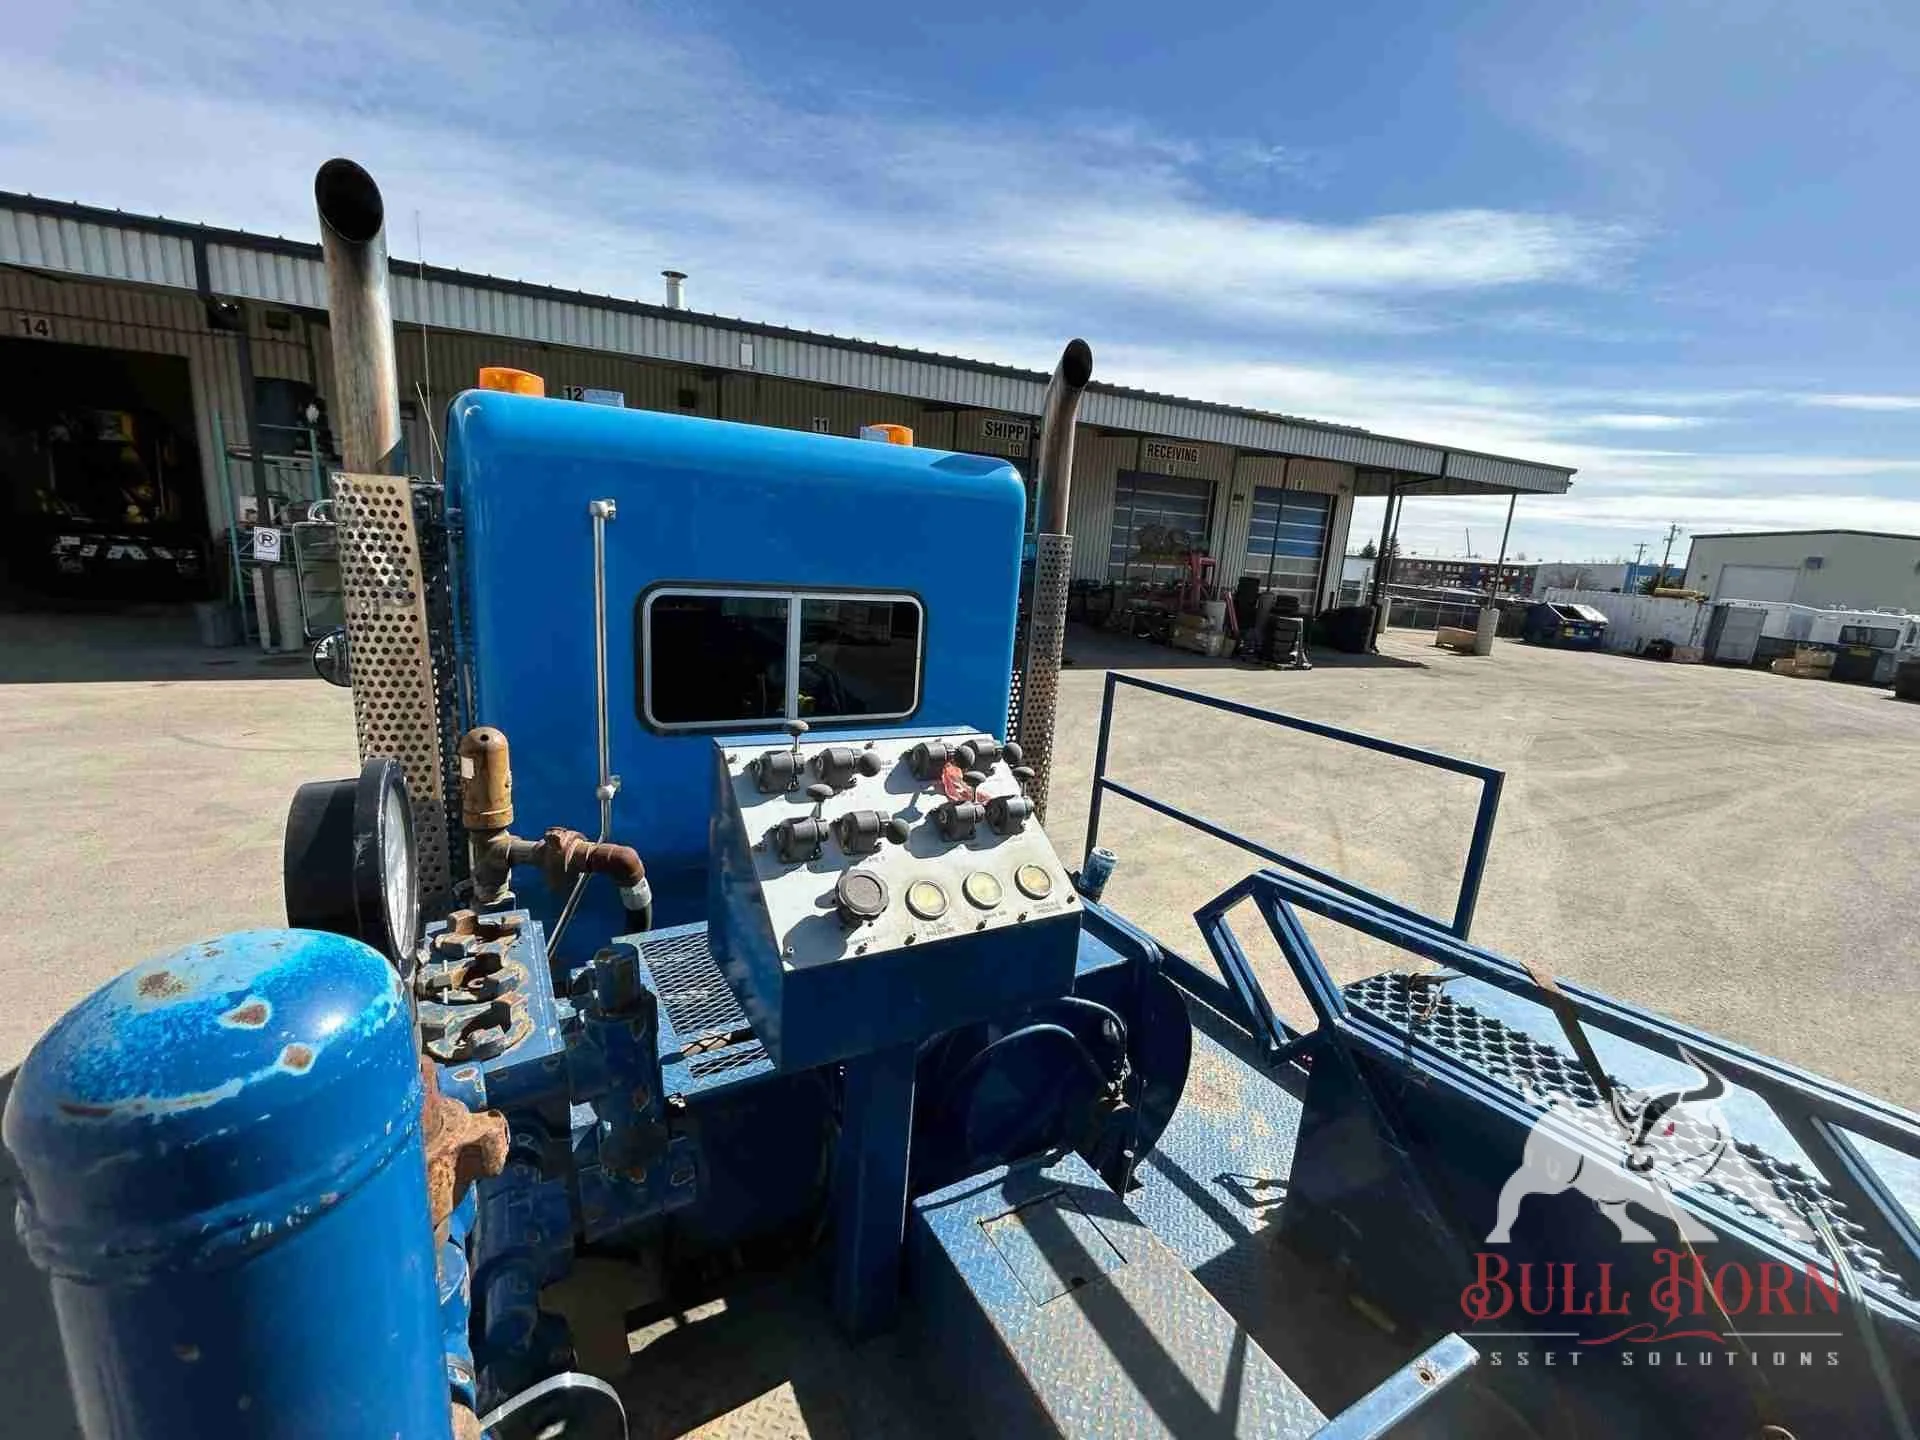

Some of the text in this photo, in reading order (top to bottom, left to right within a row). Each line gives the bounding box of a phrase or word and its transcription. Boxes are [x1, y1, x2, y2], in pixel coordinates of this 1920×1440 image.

[21, 318, 49, 337] 14
[565, 387, 583, 401] 12
[814, 418, 829, 432] 11
[985, 420, 1040, 441] SHIPPI
[1147, 443, 1198, 462] RECEIVING
